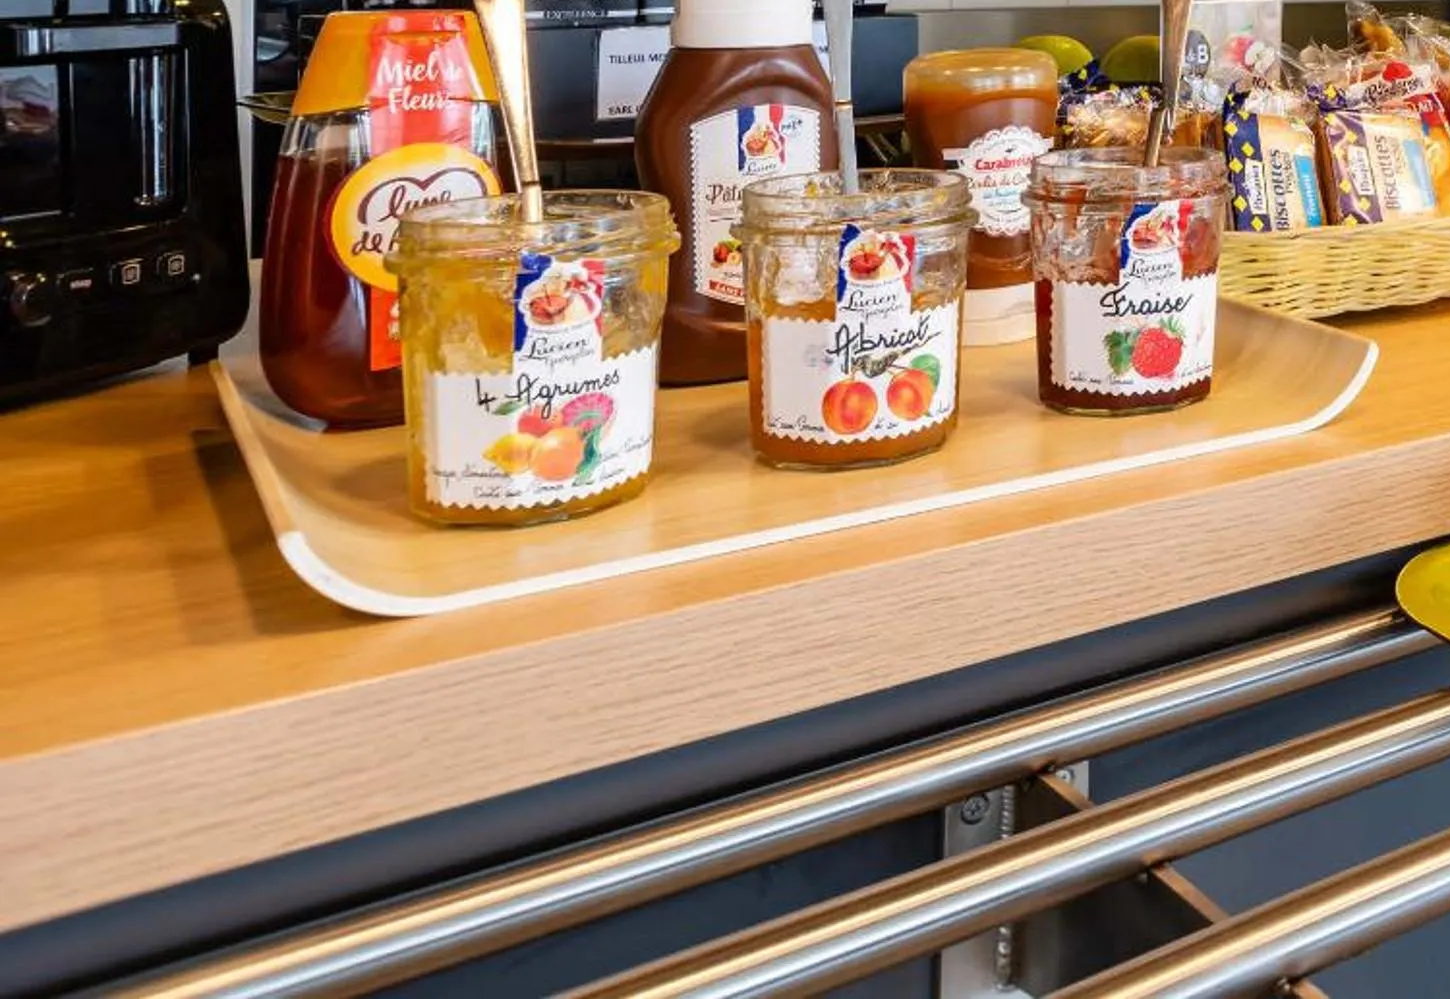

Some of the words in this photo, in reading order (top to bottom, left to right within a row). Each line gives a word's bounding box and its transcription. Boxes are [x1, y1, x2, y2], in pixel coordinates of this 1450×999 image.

[376, 50, 440, 87] Miel
[840, 288, 897, 312] Lucien
[1100, 281, 1194, 318] Fraise
[523, 336, 589, 360] Lucien
[826, 314, 936, 375] Abricot
[475, 377, 497, 415] 4
[505, 369, 621, 421] Agrumes
